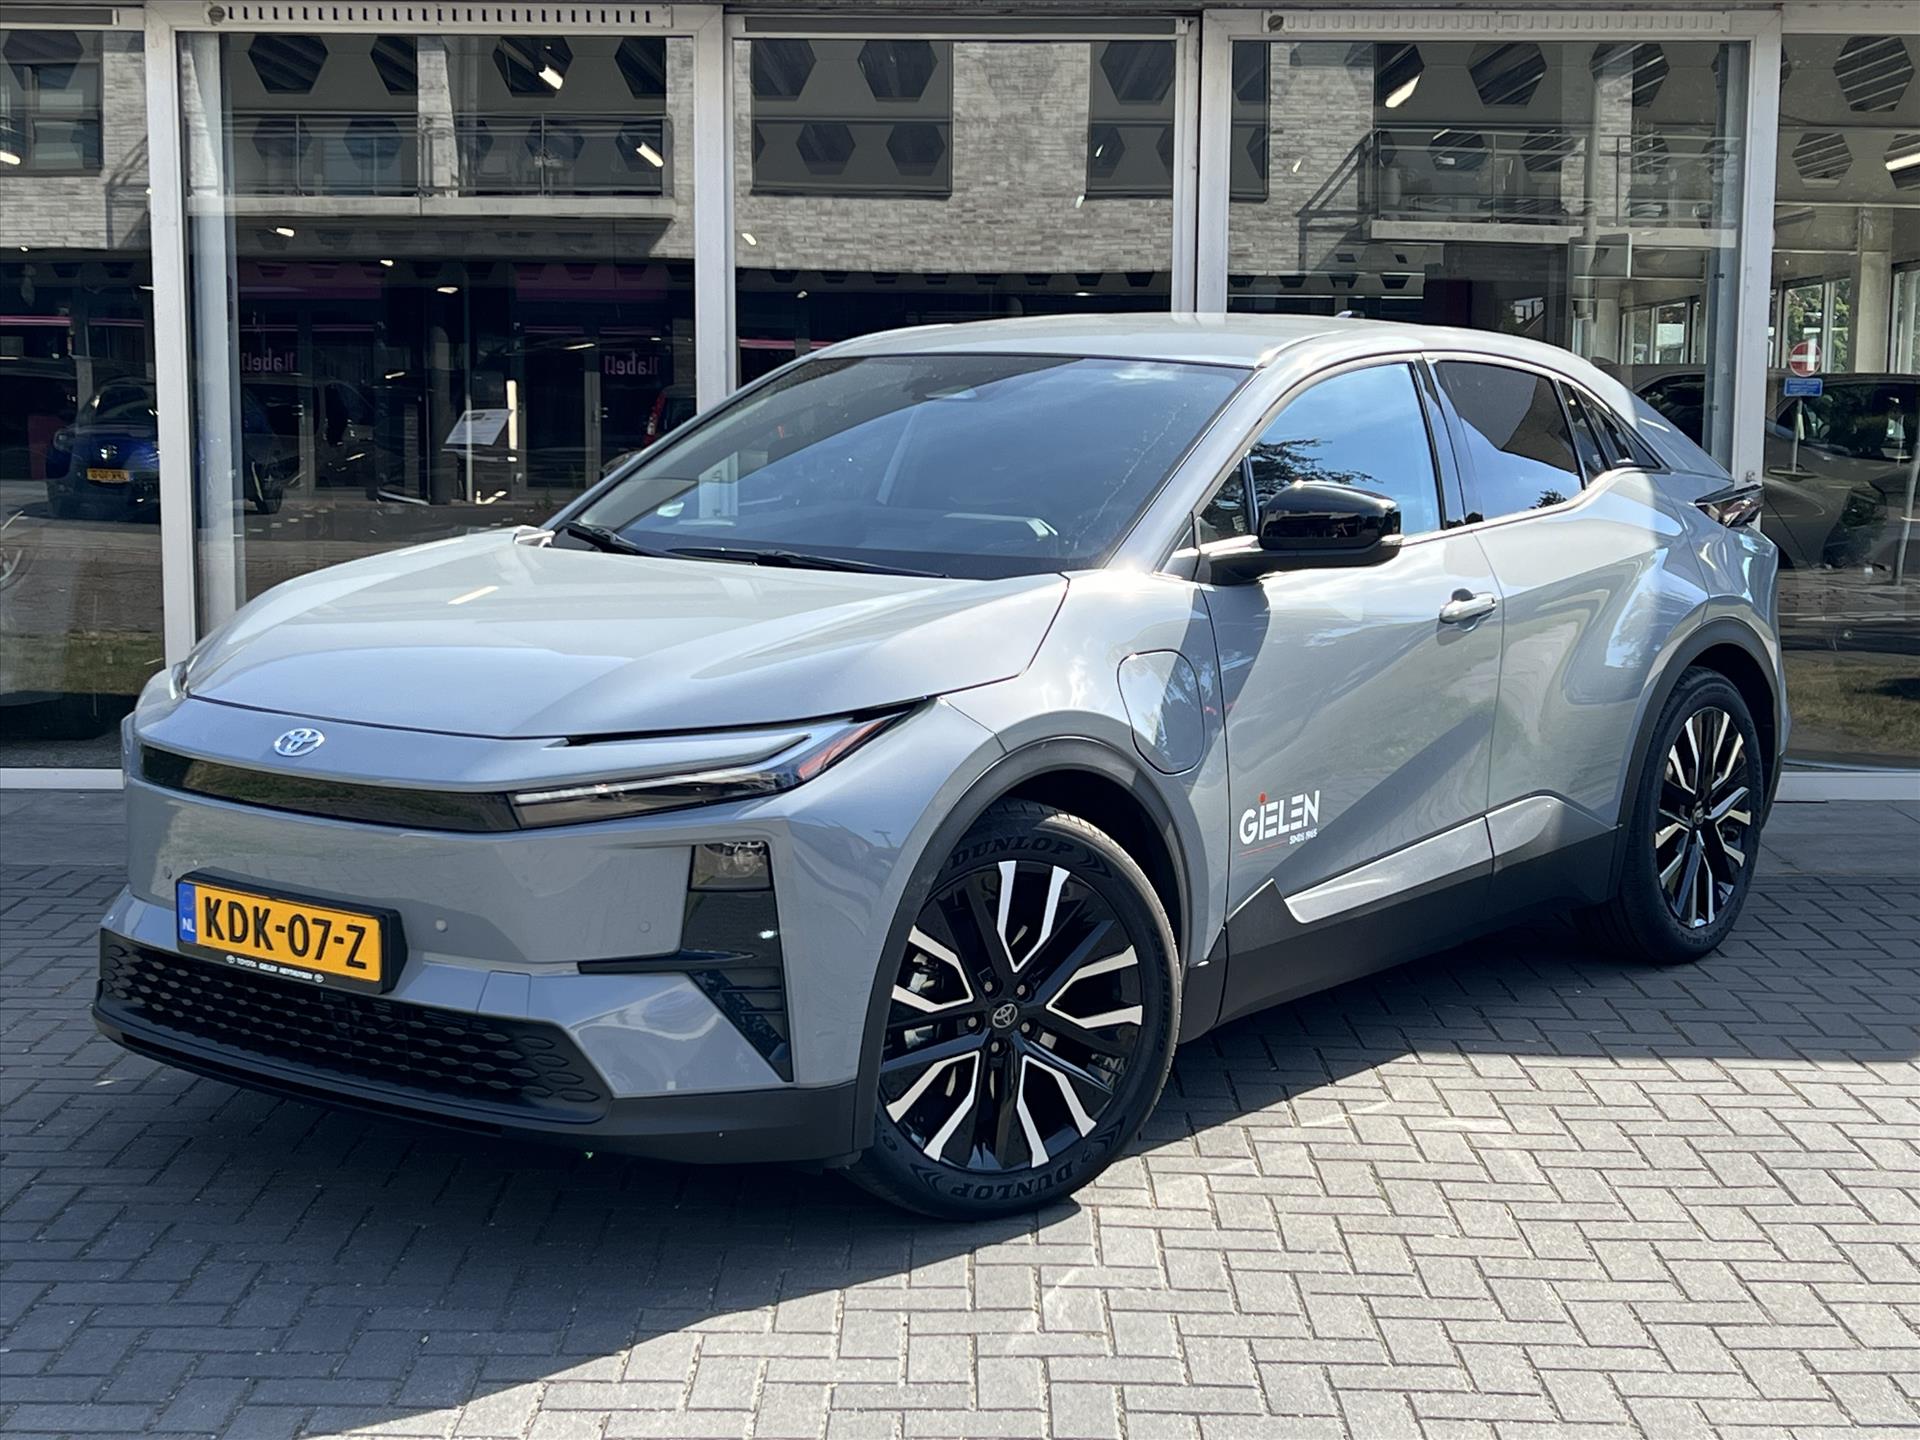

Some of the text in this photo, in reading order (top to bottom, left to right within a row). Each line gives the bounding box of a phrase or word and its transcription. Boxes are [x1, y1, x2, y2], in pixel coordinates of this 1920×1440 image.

[1240, 790, 1320, 845] GIELEN
[951, 836, 1075, 869] DUNLOP
[182, 917, 195, 932] NL
[204, 896, 367, 970] KDK-07-Z
[951, 1161, 1073, 1199] DUNLOP
